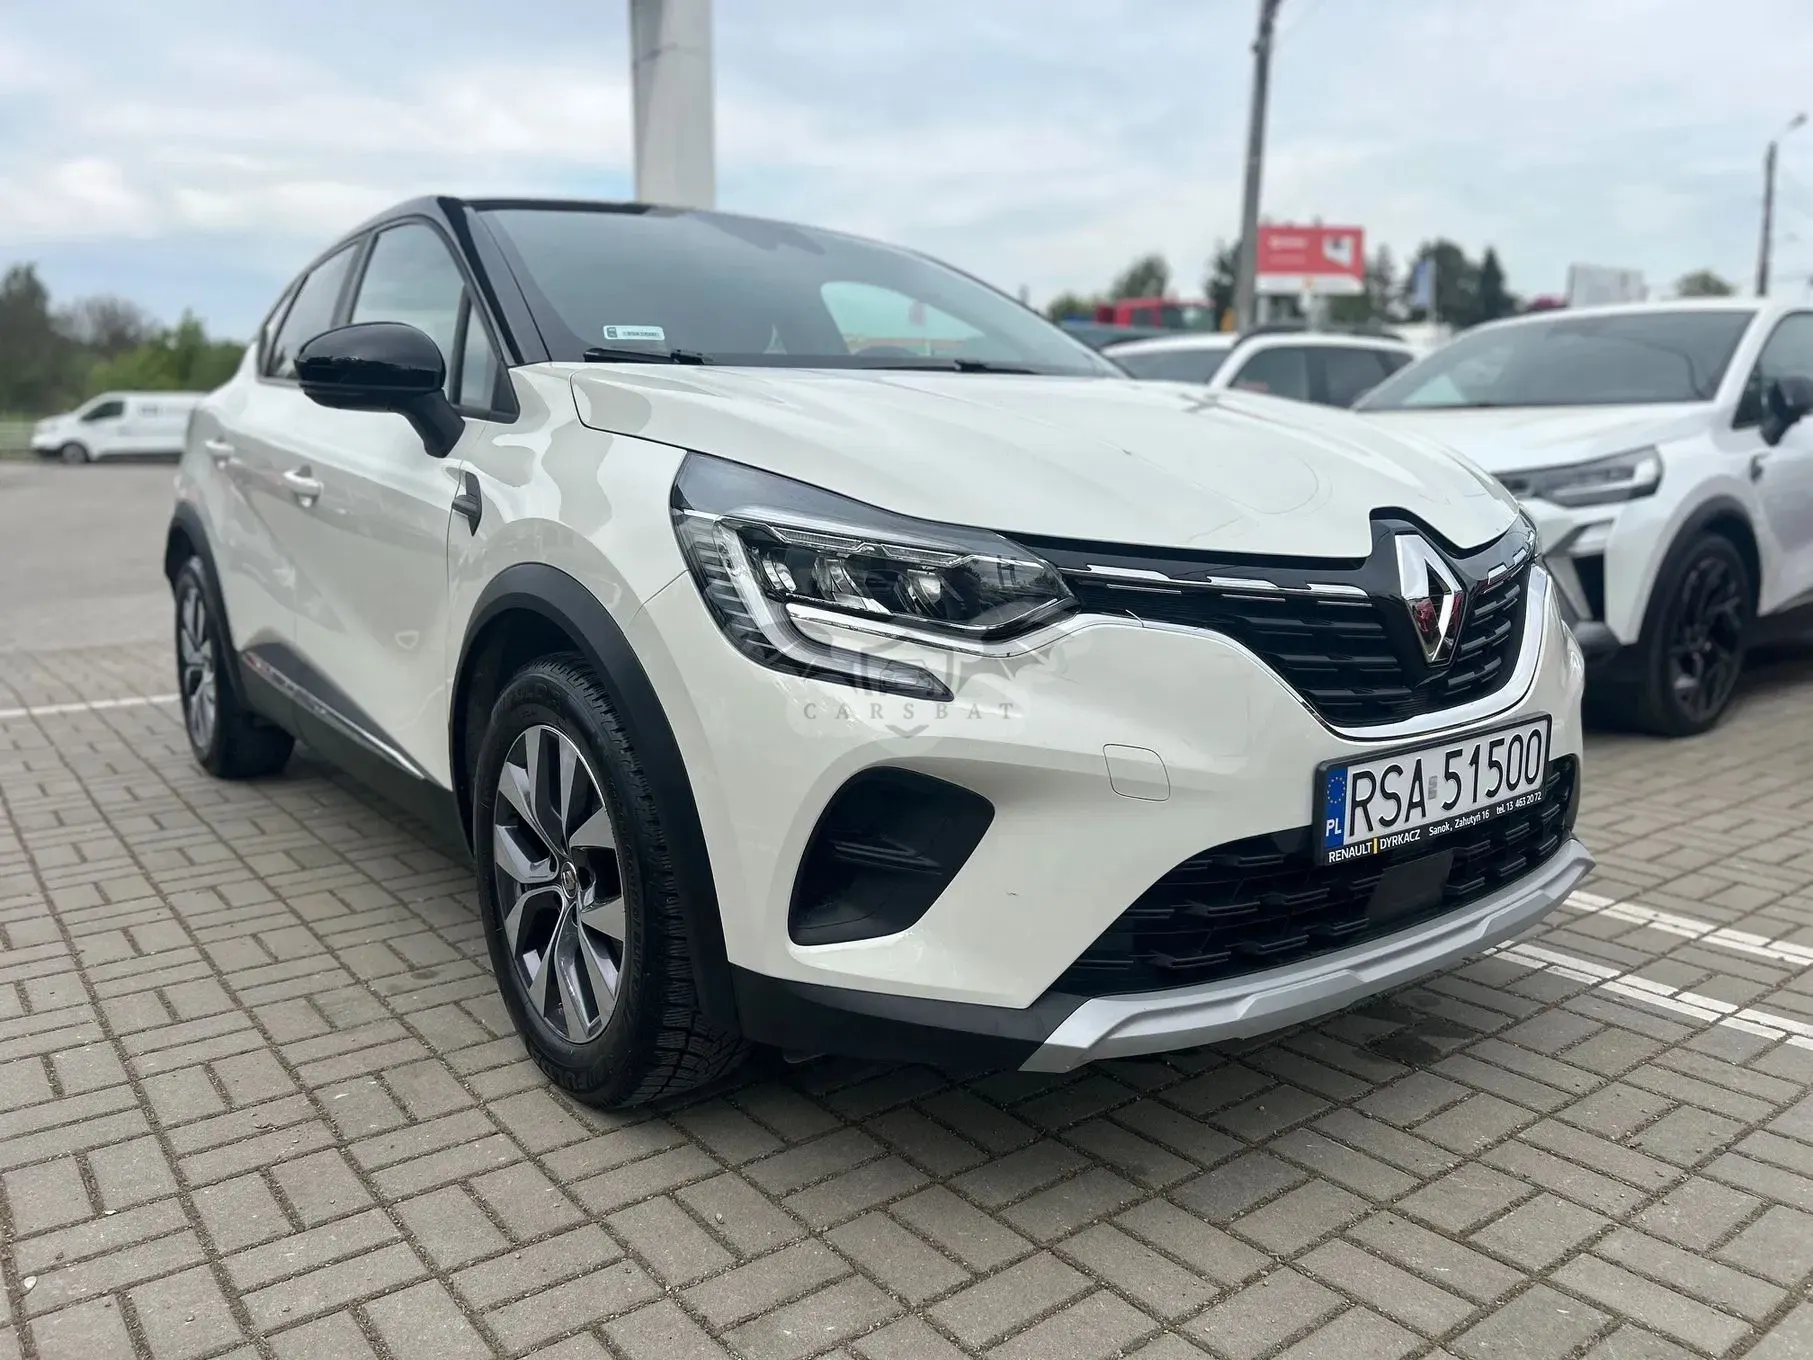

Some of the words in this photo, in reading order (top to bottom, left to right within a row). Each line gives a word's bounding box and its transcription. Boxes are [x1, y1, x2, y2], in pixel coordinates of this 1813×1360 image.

[1349, 758, 1427, 837] RSA
[1441, 728, 1543, 812] 51500
[1325, 817, 1342, 837] PL
[1328, 841, 1373, 863] RENAULT
[1380, 829, 1421, 850] DYRKACZ
[1482, 809, 1490, 820] 16
[1506, 801, 1514, 812] 13
[1526, 793, 1534, 805] 20
[1534, 791, 1542, 802] 72
